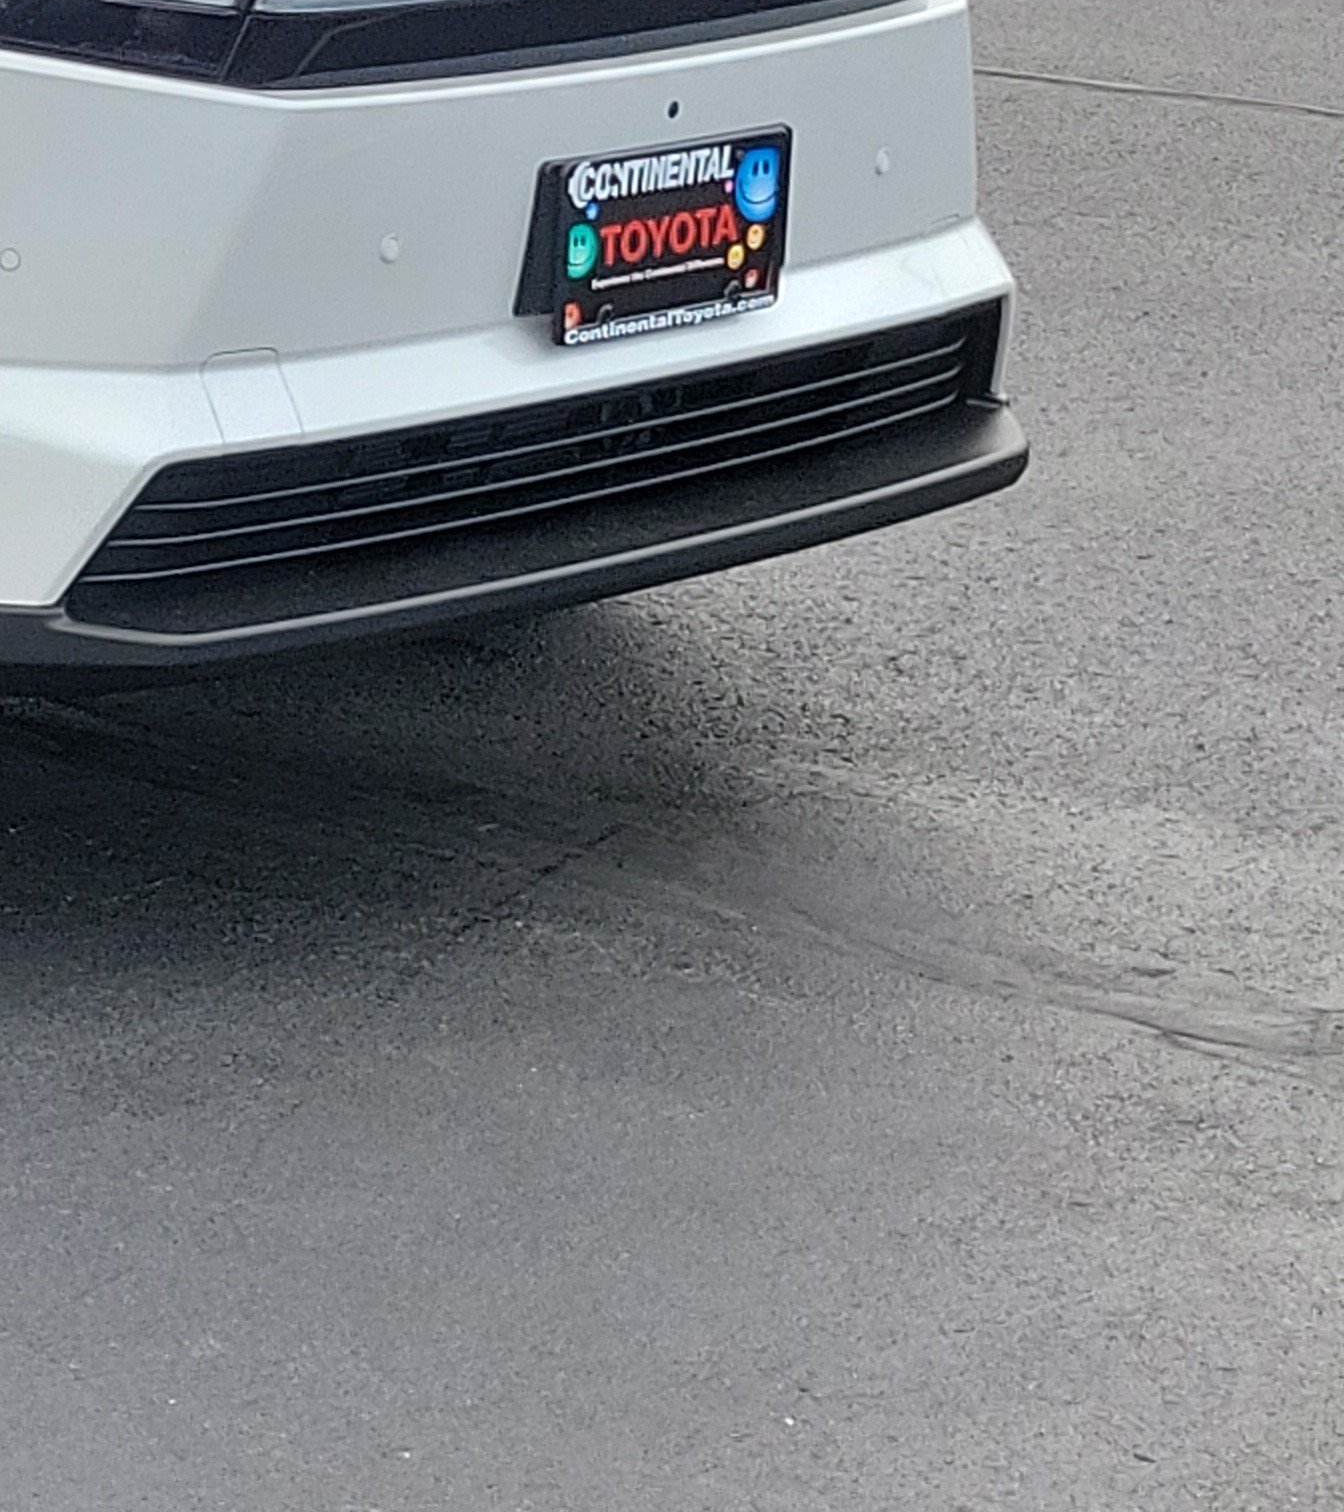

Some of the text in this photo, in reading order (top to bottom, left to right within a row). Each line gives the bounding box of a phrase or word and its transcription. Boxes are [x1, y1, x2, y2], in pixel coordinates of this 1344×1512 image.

[568, 144, 735, 209] CONTINENTAL
[599, 203, 740, 267] TOYOTA
[564, 294, 775, 346] ContinentalToyota.com
